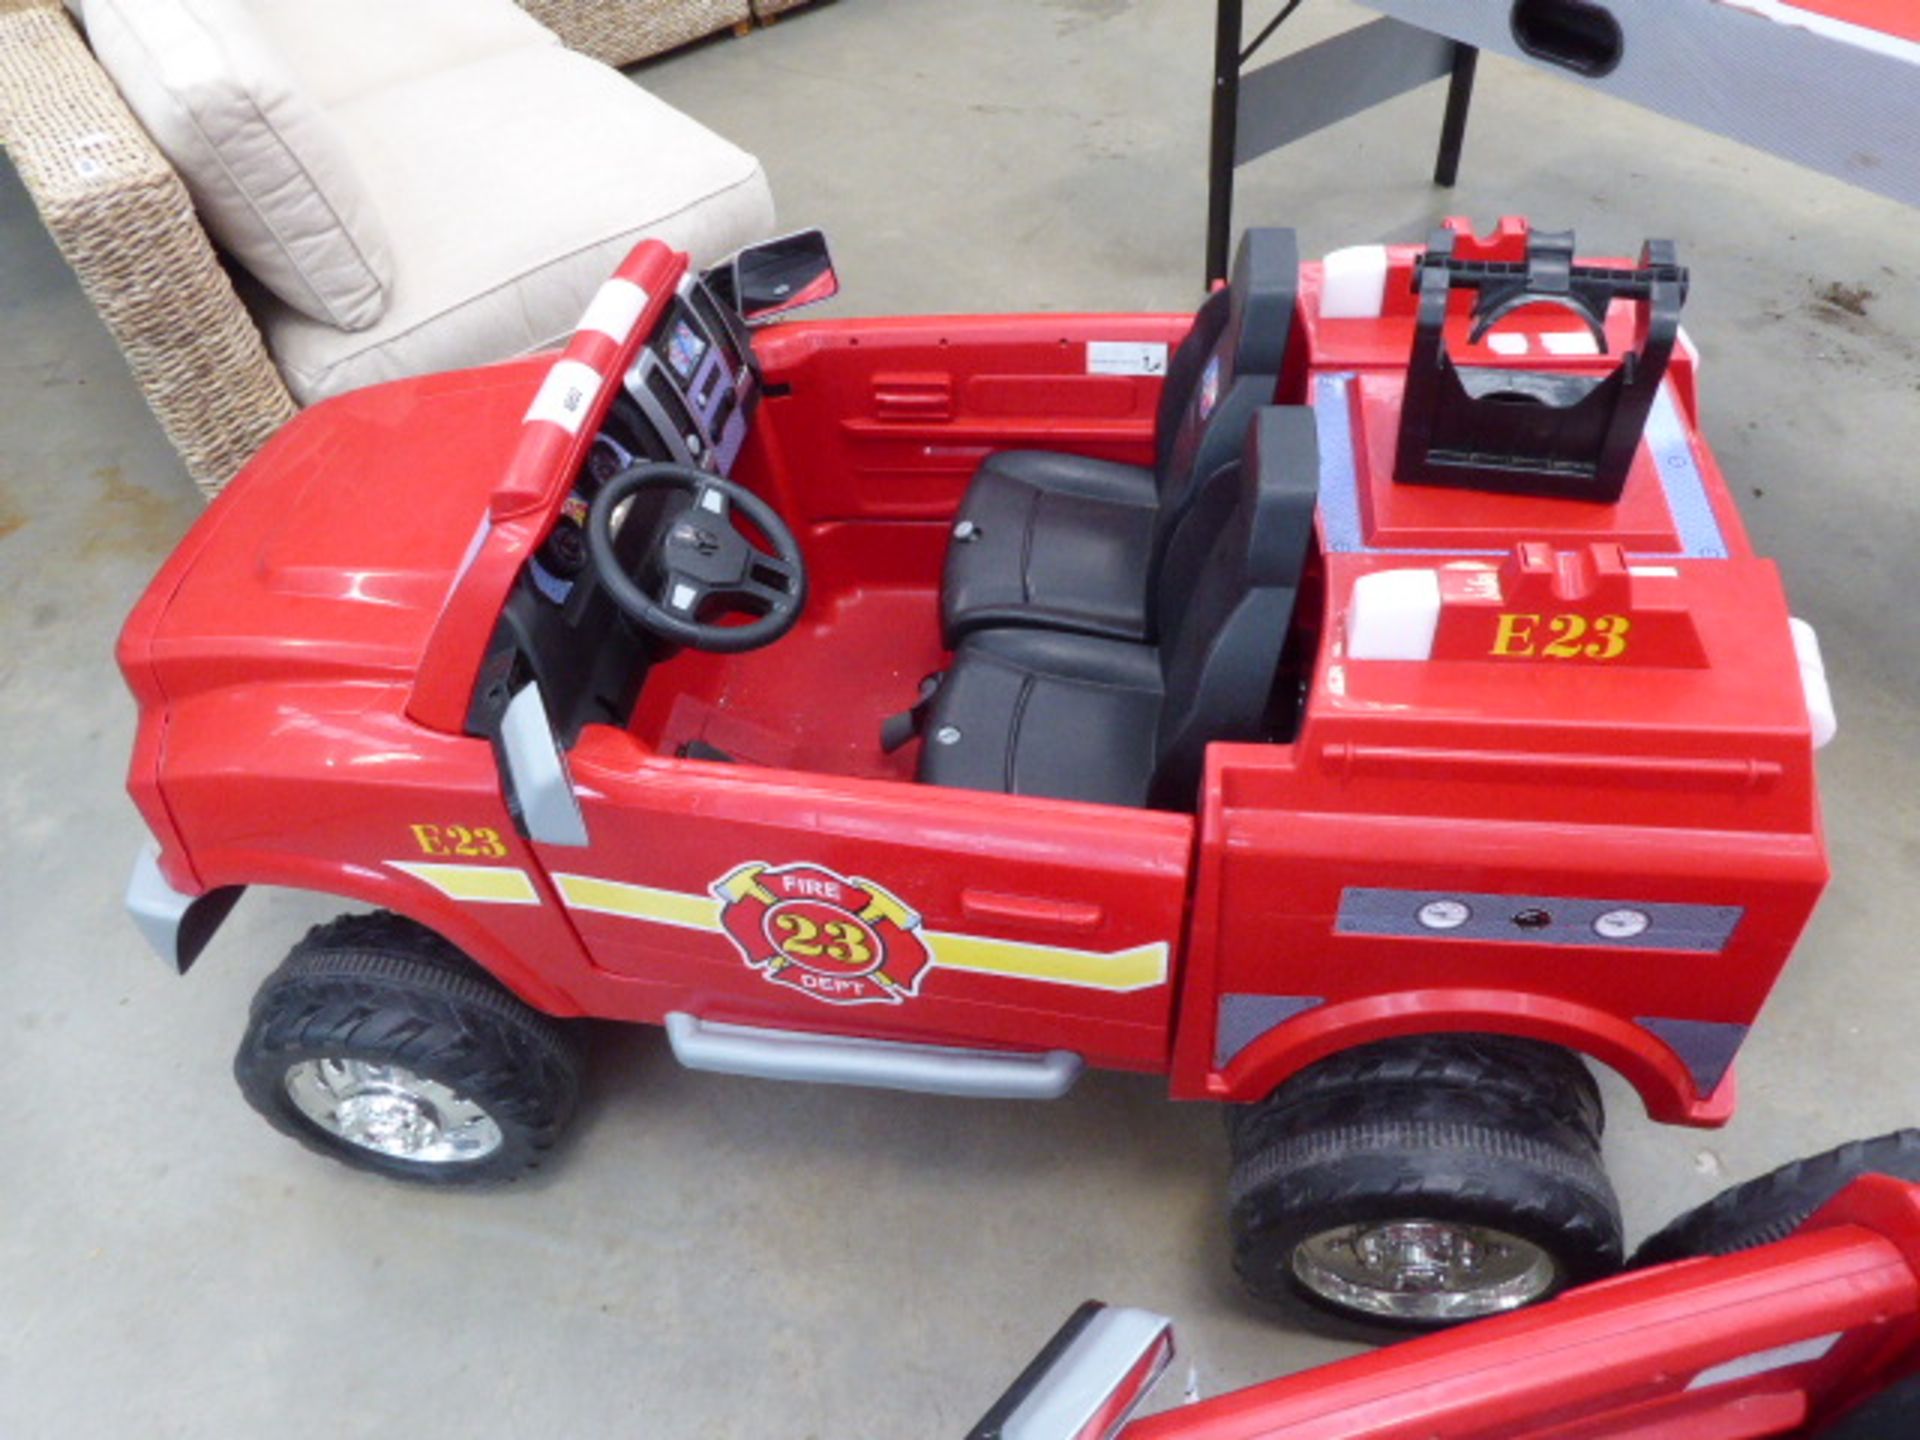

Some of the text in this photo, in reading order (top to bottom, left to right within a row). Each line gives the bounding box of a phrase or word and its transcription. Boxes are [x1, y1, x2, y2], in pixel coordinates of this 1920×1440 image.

[1488, 614, 1631, 659] E23
[409, 823, 508, 858] E23
[780, 874, 841, 899] FIRE
[776, 914, 871, 964] 23
[800, 973, 865, 995] DEPT
